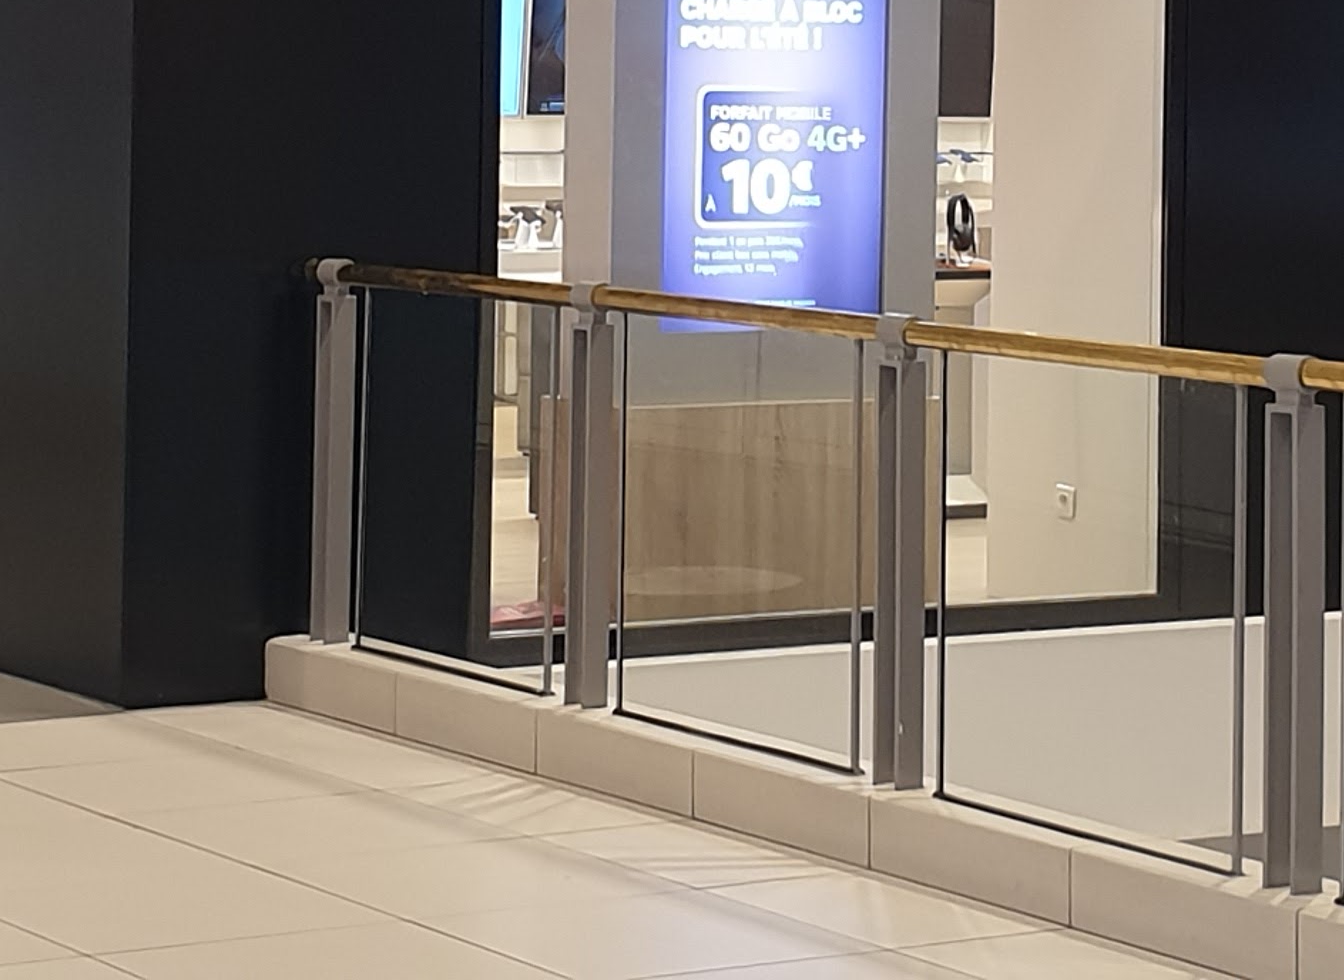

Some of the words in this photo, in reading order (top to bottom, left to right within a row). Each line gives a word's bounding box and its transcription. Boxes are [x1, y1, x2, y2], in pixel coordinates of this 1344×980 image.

[802, 0, 864, 24] BLOC
[680, 25, 747, 50] POUR
[710, 104, 774, 121] FORFAIT
[709, 122, 752, 153] 60
[757, 123, 801, 152] Go
[807, 124, 867, 152] 4G+
